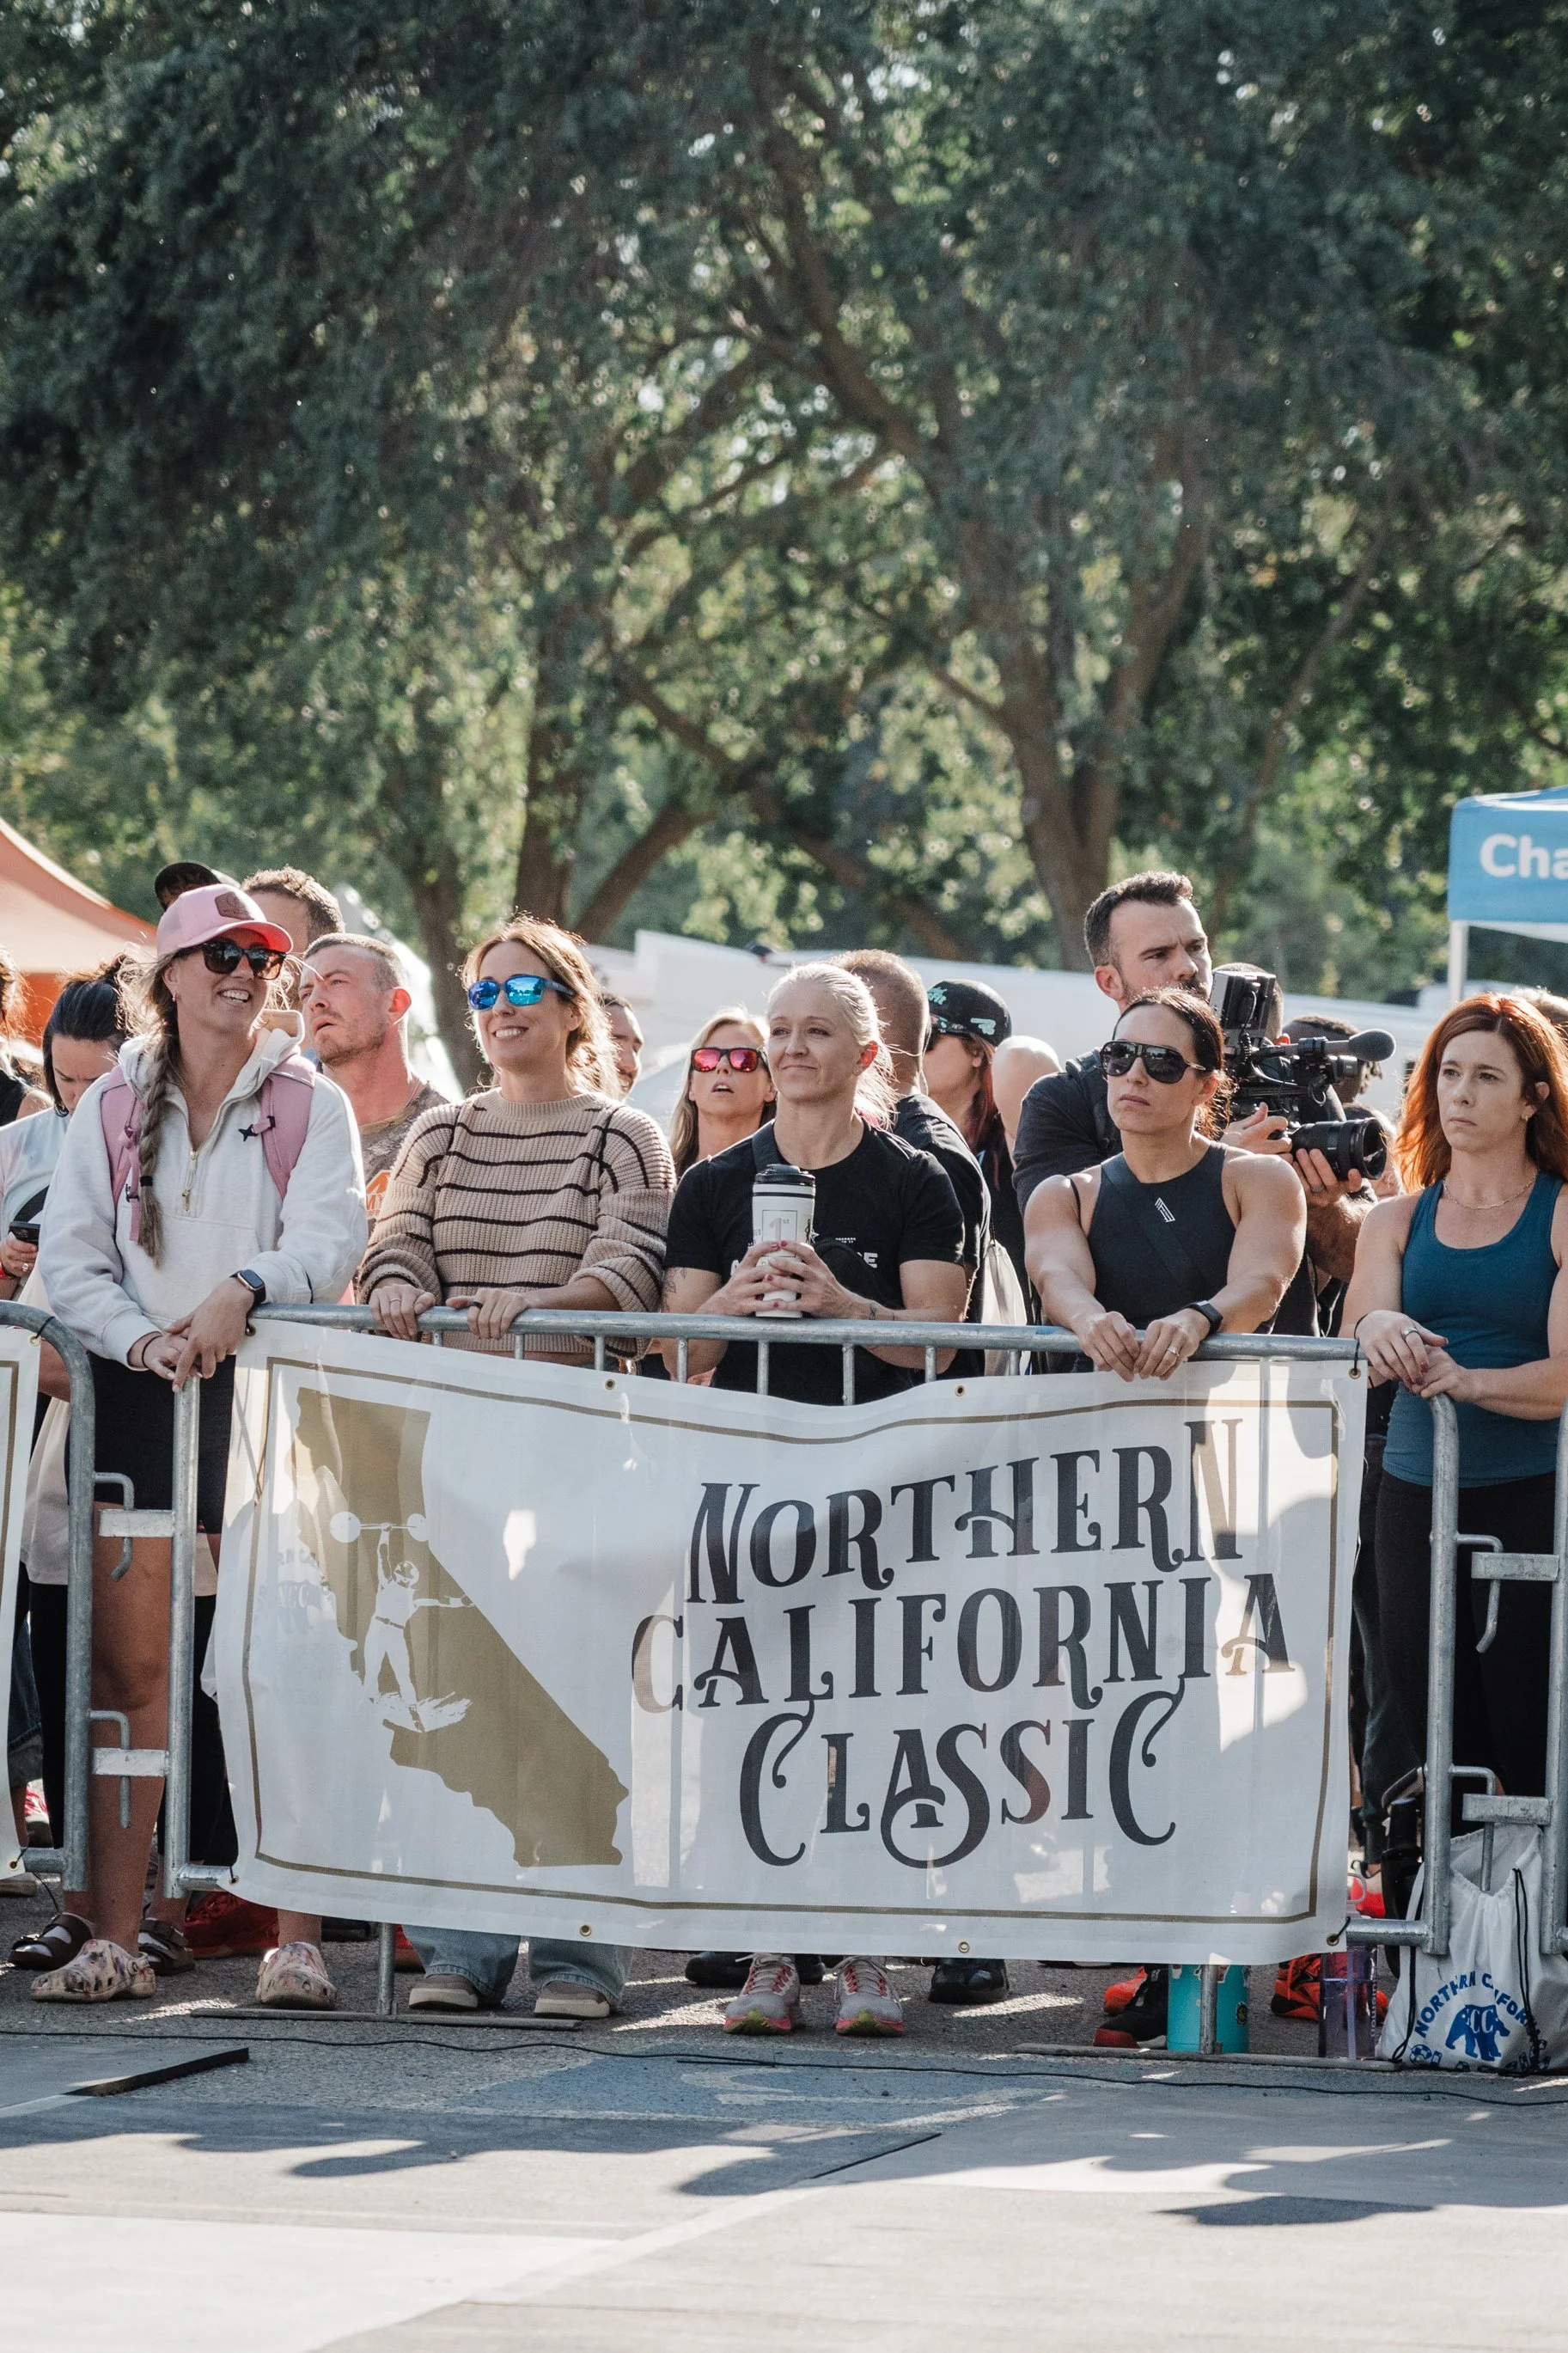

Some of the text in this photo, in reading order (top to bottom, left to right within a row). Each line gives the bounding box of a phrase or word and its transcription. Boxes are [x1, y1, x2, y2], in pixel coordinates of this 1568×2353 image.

[686, 1418, 1244, 1604] NORTHERN
[631, 1573, 1295, 1713] CALIFORNIA
[740, 1680, 1186, 1868] CLASSIC
